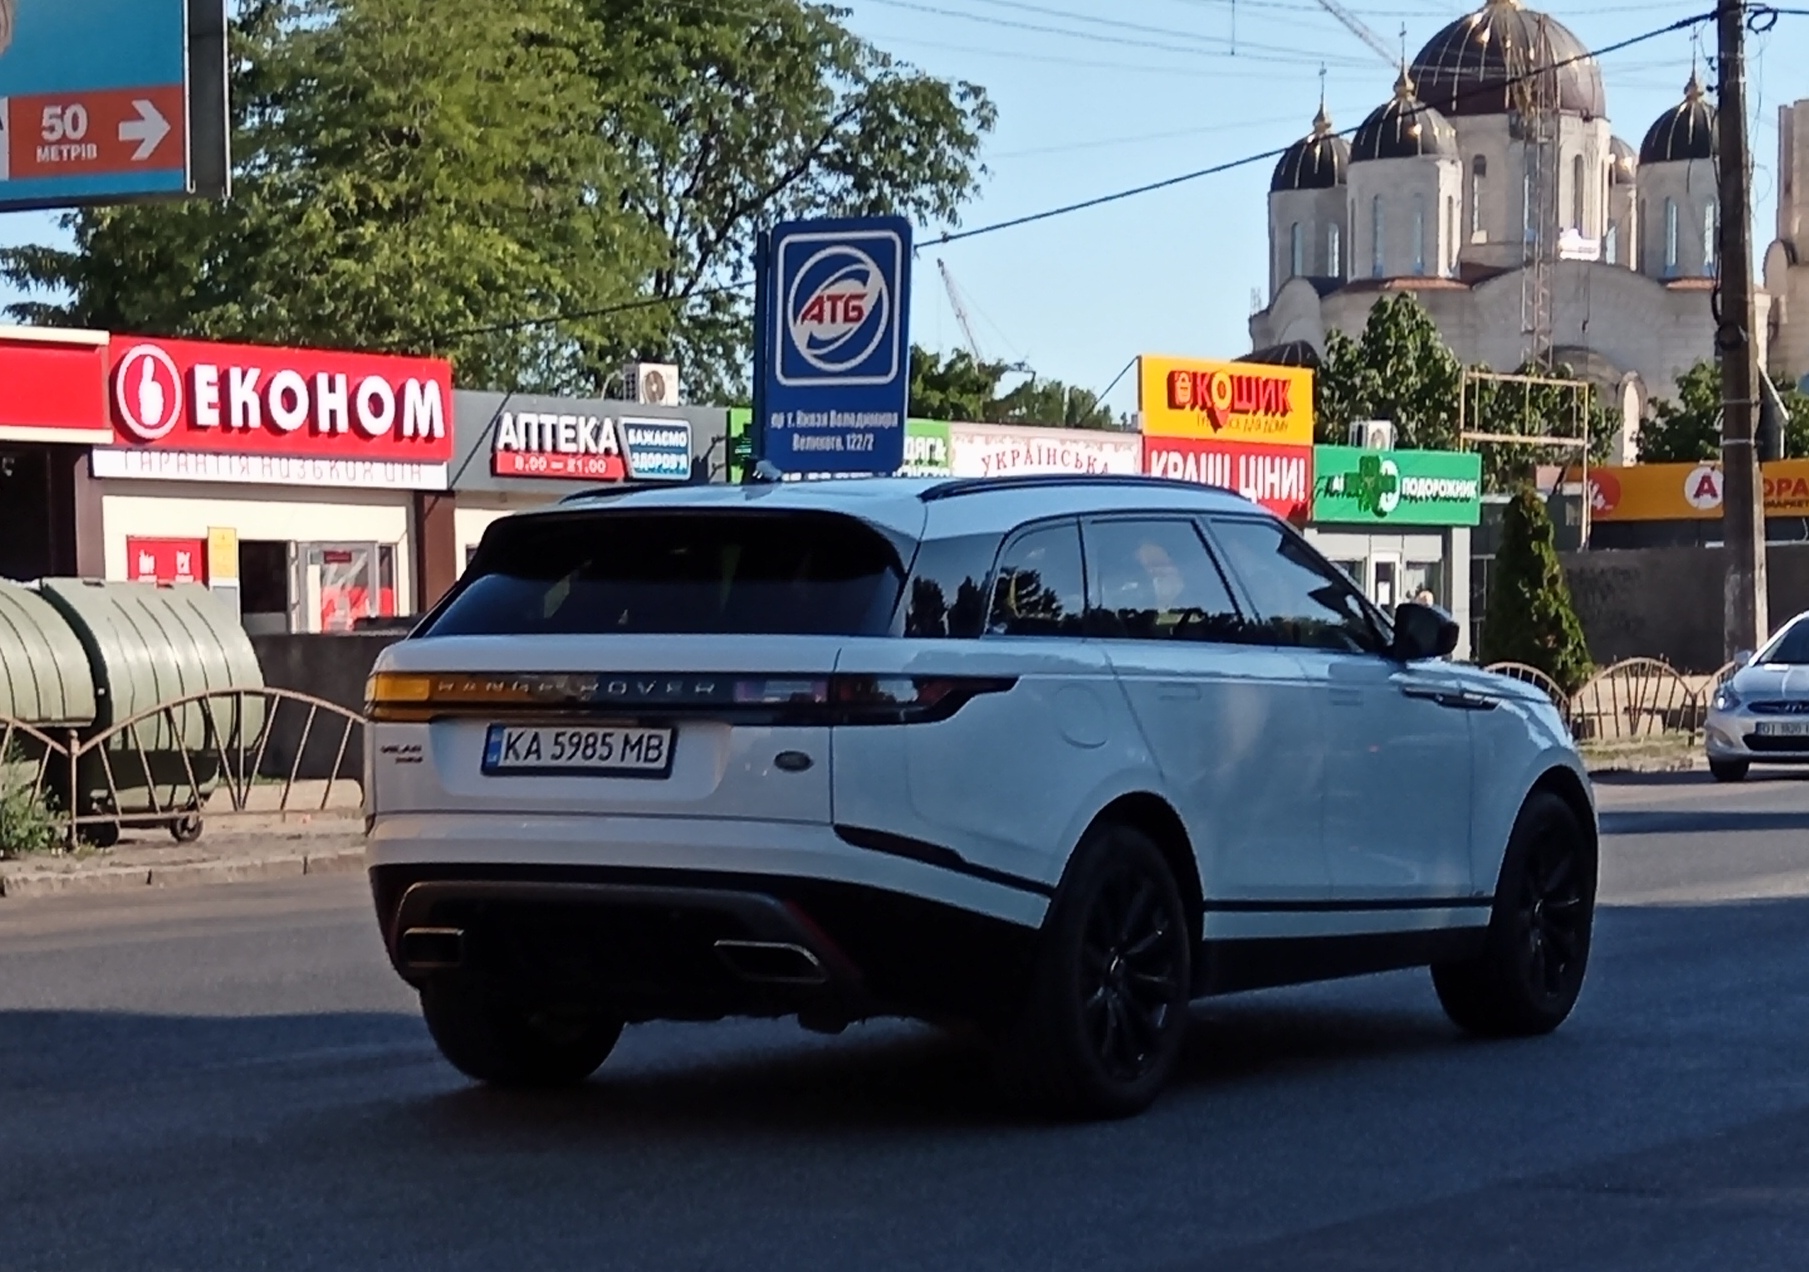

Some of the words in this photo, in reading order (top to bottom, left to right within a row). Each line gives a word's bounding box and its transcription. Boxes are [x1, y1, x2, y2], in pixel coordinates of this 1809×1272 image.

[41, 103, 88, 142] 50
[36, 143, 98, 163] МЕТРІВ
[801, 293, 868, 325] АТБ
[195, 364, 445, 438] ЕКОНОМ
[496, 411, 620, 454] АПТЕКА
[846, 432, 874, 451] 122/2
[980, 444, 1110, 478] УКРАЇНСЬКА
[1239, 454, 1306, 504] ЦІНИ!
[1401, 476, 1477, 499] ПОДОРОЖНИК
[502, 730, 542, 762] KA
[550, 731, 616, 762] 5985
[620, 733, 665, 764] MB
